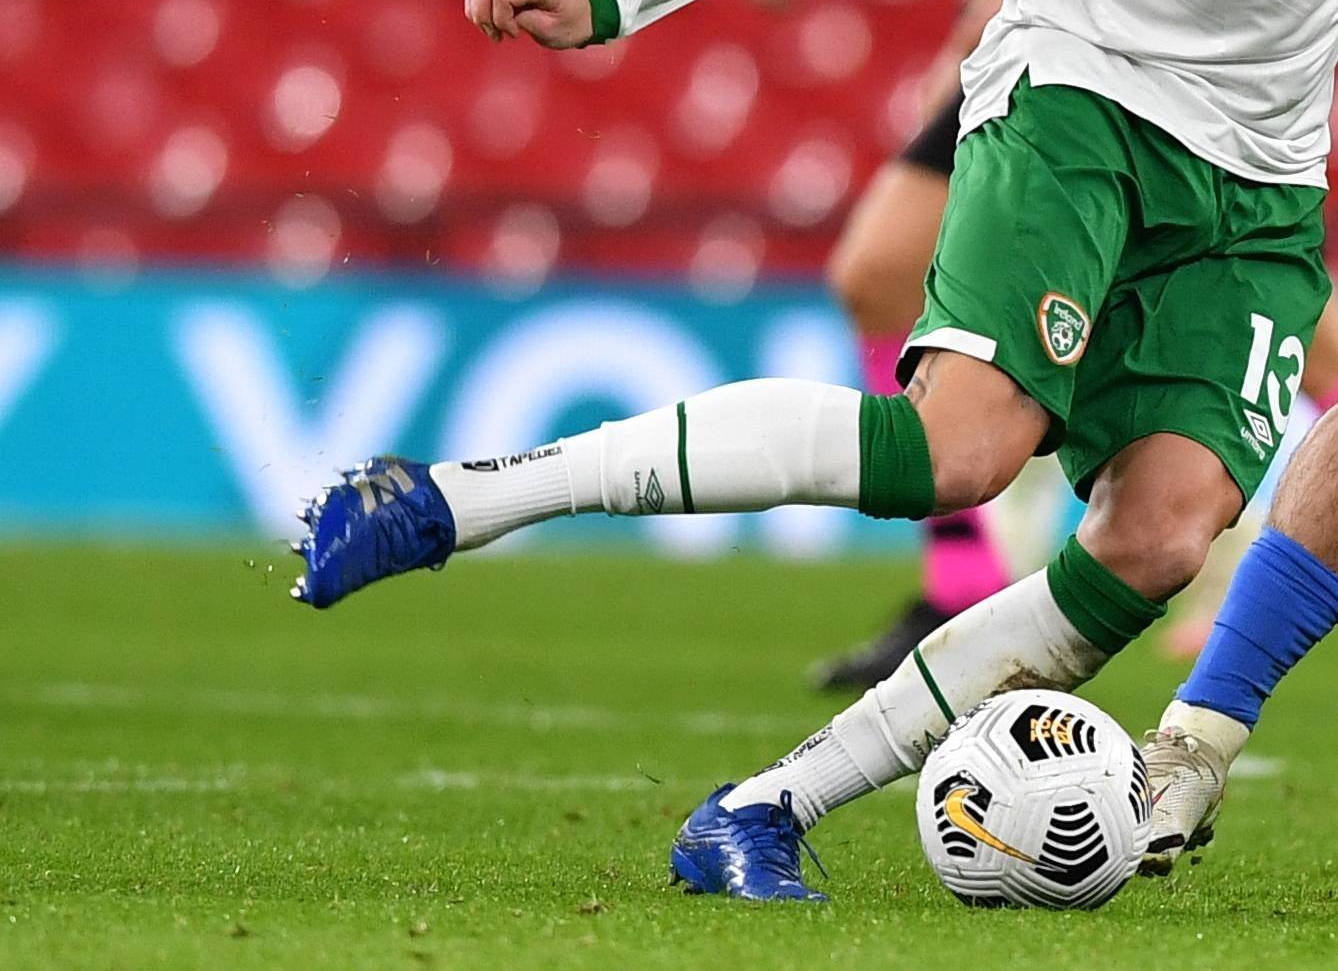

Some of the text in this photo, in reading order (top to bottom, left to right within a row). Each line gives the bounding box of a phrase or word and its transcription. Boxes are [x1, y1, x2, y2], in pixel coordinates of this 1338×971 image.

[1053, 302, 1083, 331] Ireland
[1240, 312, 1305, 434] 13
[1240, 426, 1266, 460] umbro
